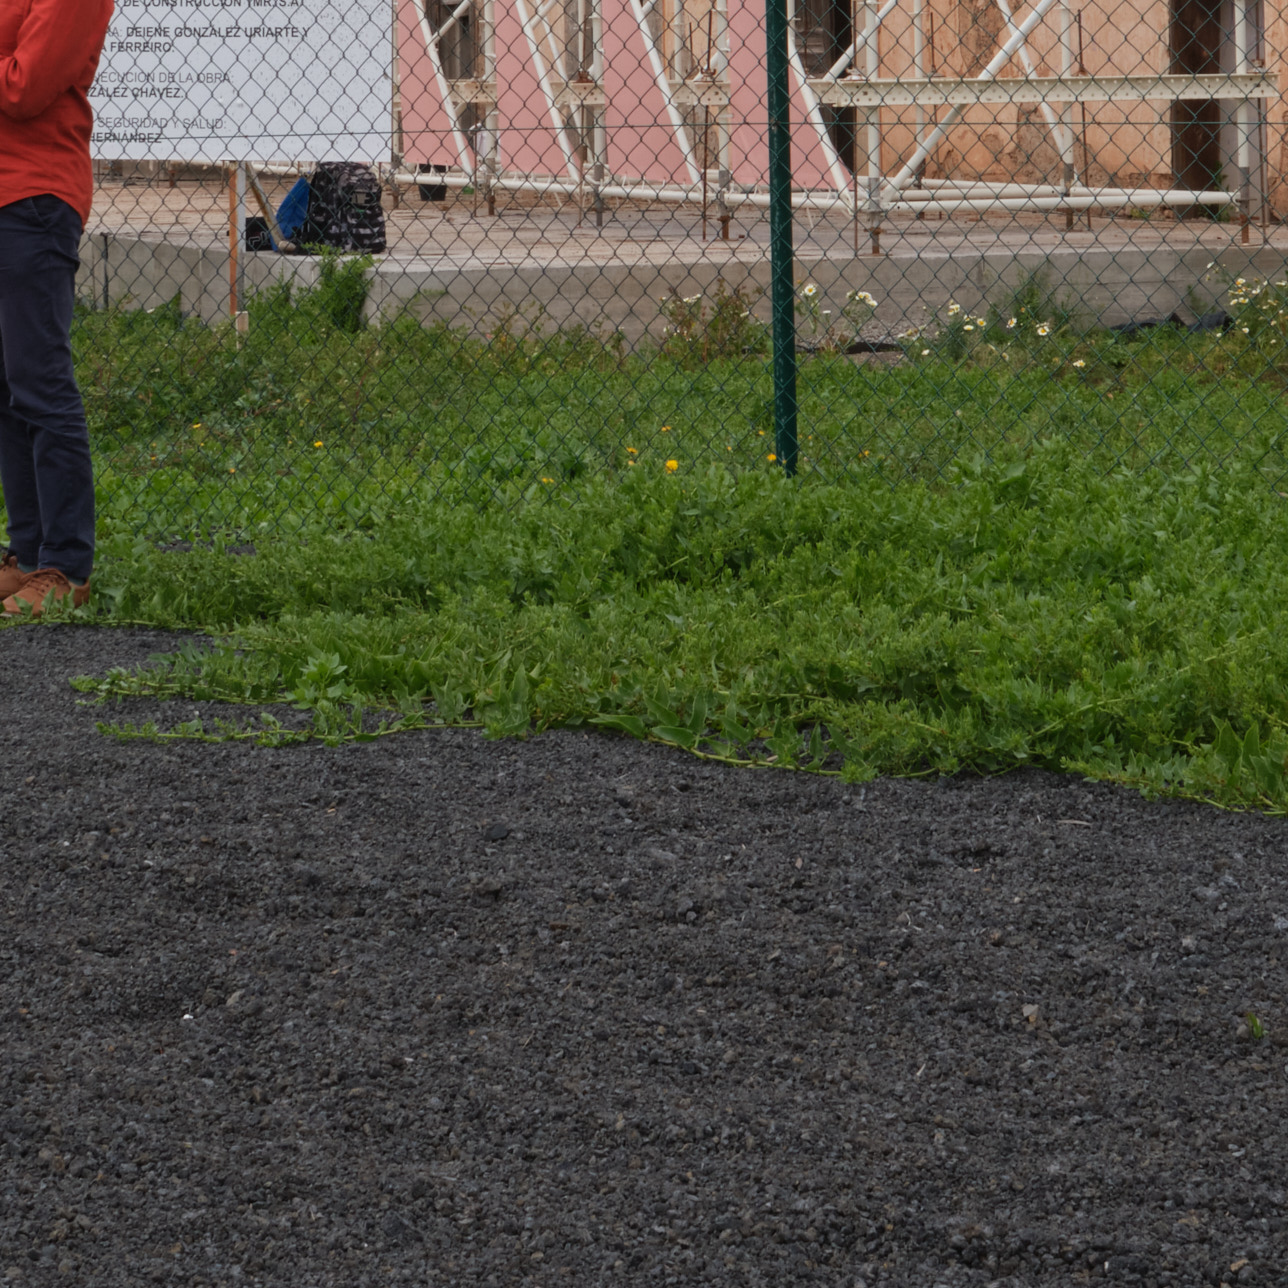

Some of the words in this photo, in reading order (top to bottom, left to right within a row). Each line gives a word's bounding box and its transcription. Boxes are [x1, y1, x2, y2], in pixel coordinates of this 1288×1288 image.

[244, 26, 299, 38] URIARTE
[302, 26, 310, 38] Y
[159, 72, 175, 83] DE
[179, 72, 194, 83] LA
[97, 116, 168, 129] SEGURIDAD
[172, 117, 180, 129] Y
